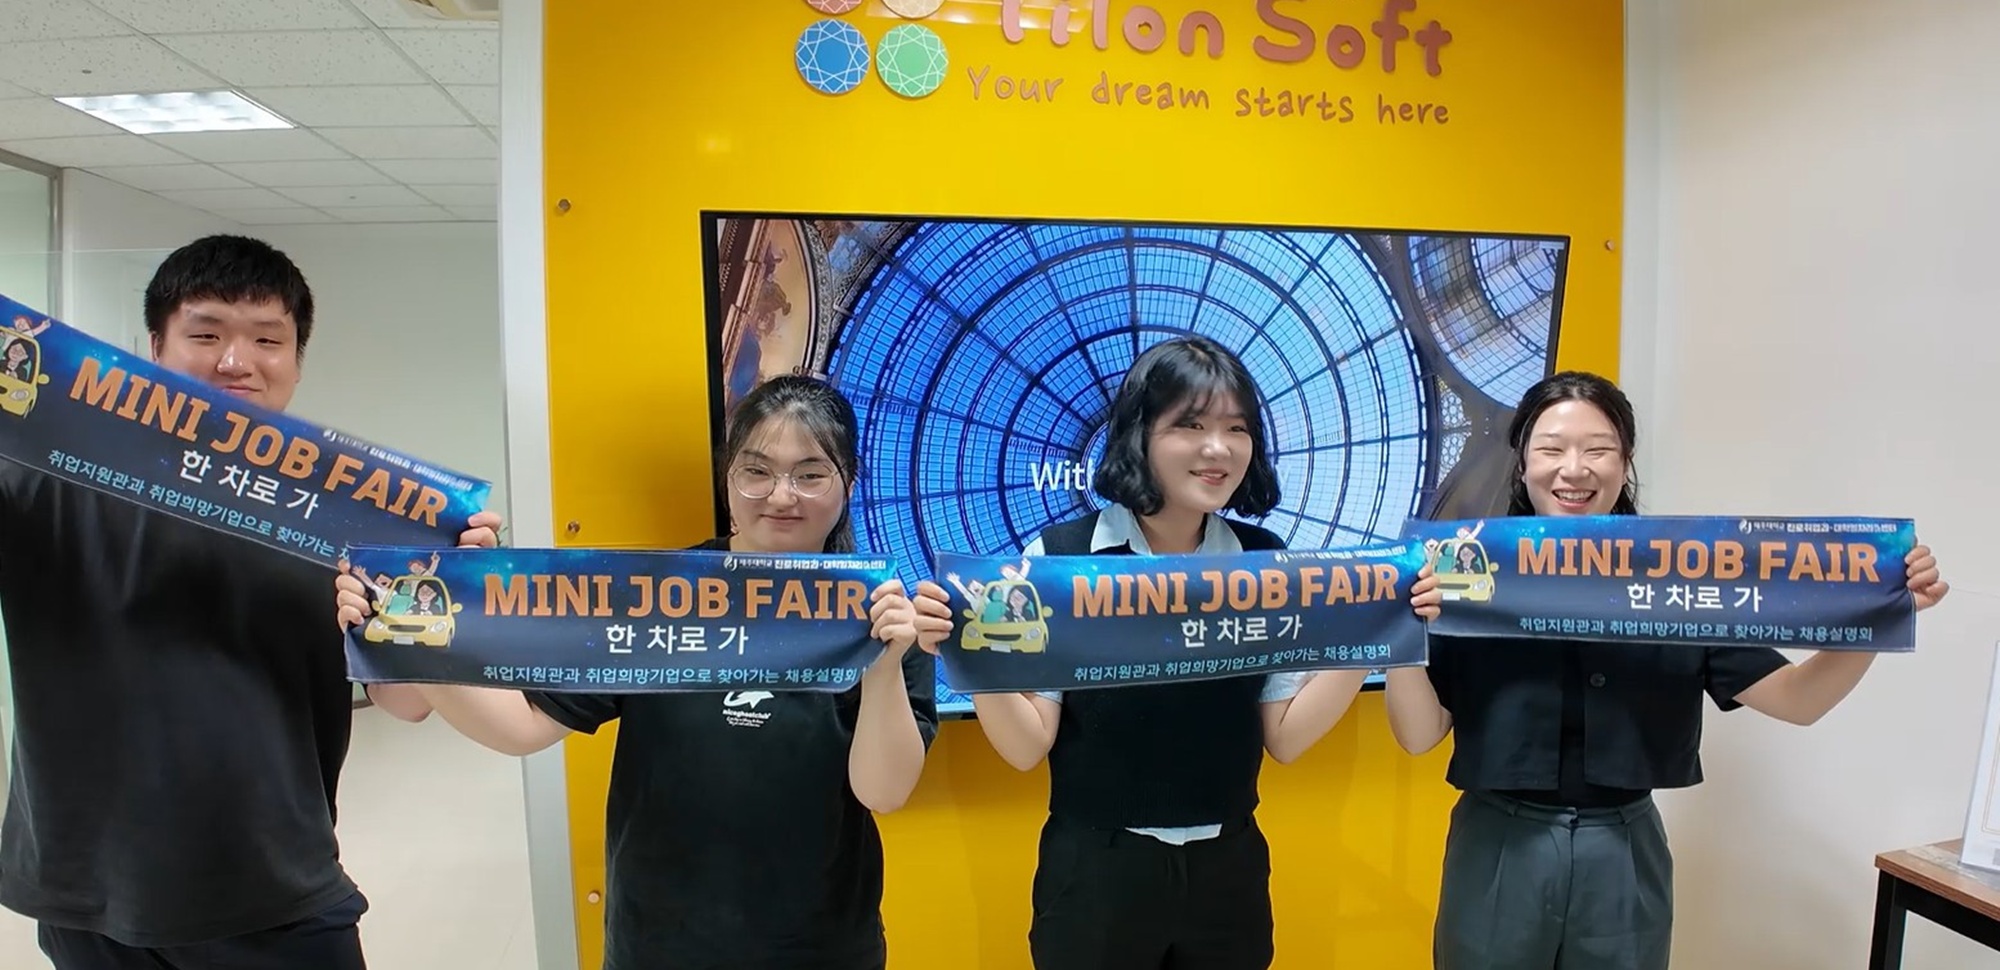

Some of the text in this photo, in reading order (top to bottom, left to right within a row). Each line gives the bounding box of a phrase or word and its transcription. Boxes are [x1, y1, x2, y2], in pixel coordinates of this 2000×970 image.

[1252, 0, 1453, 77] Soft
[967, 64, 1450, 125] Your dream starts here
[70, 355, 211, 443] MINI
[210, 412, 320, 479] JOB
[324, 451, 449, 528] FAIR
[180, 449, 320, 520] 한 차로 가
[1030, 459, 1094, 491] Wit
[48, 449, 336, 558] 취업지원관과 취업희망기업으로 찾아가는
[1517, 537, 1881, 584] MINI JOB FAIR
[484, 574, 869, 621] MINI JOB FAIR
[1072, 563, 1400, 618] MINI JOB FAIR
[1627, 583, 1763, 613] 한 차로 가
[606, 624, 750, 657] 한 차로 가
[1181, 614, 1304, 649] 한 차로 가
[1518, 617, 1874, 642] 취업지원관과 취업희망기업으로 찾아가는 채용설명회
[483, 665, 858, 684] 취업지원관과 취업희망기업으로 찾아가는 채용설명회
[1073, 643, 1392, 682] 취업지원관과 취업희망기업으로 찾아가는 채용설명회
